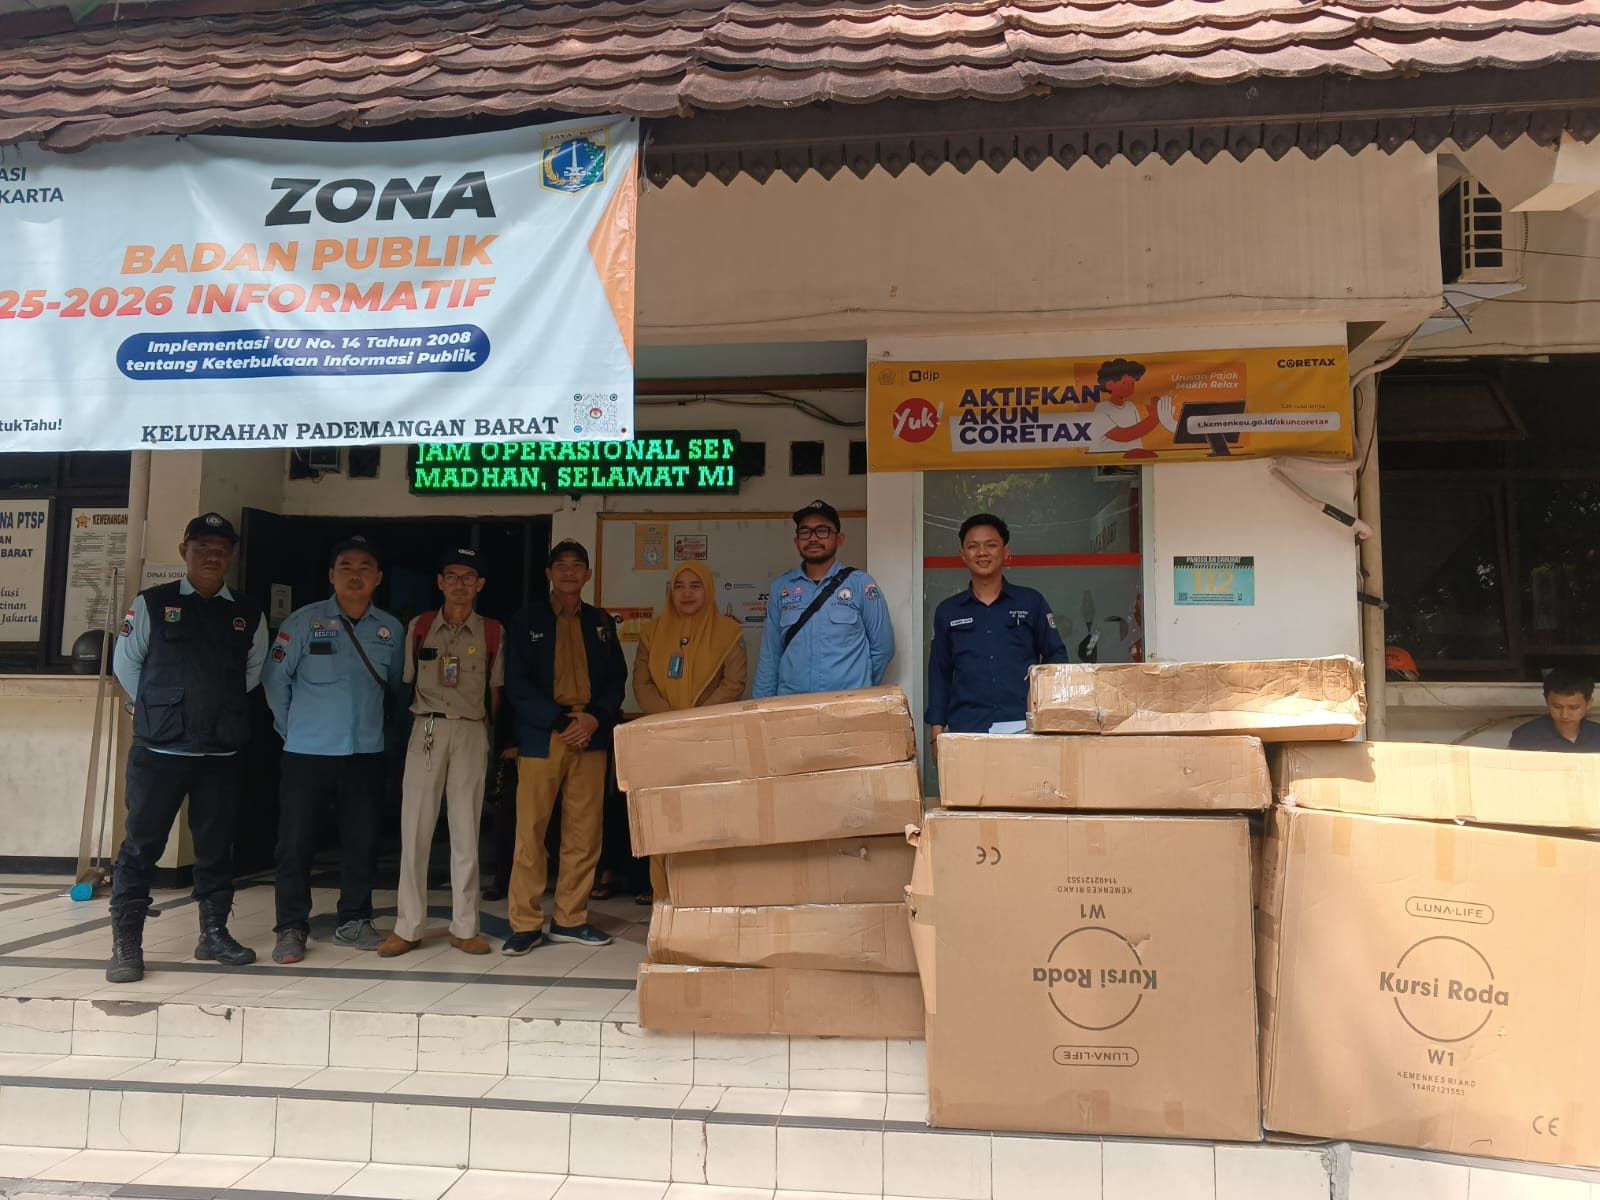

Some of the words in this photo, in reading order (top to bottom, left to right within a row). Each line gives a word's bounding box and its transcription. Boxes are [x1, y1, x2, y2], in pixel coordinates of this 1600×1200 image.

[265, 171, 496, 227] ZONA
[120, 241, 298, 275] BADAN
[312, 234, 498, 271] PUBLIK
[186, 277, 496, 314] INFORMATIF
[148, 336, 269, 354] Implementasi
[274, 337, 301, 349] UU
[305, 337, 335, 349] No.
[342, 338, 360, 348] 14
[366, 336, 421, 347] Tahun
[426, 332, 471, 345] 2008
[126, 358, 197, 372] tentang
[202, 354, 318, 369] Keterbukaan
[323, 351, 414, 367] Informasi
[417, 349, 475, 363] Publik
[1277, 358, 1335, 368] CORETAX
[1171, 373, 1207, 382] Urusan
[1210, 372, 1239, 382] Pajak
[1176, 381, 1207, 389] Makin
[1210, 381, 1239, 389] Relax
[959, 385, 1100, 407] AKTIFKAN
[892, 400, 945, 440] Yuk!
[959, 407, 1039, 425] AKUN
[141, 423, 288, 442] KELURAHAN
[296, 420, 466, 439] PADEMANGAN
[474, 417, 558, 436] BARAT
[959, 423, 1092, 444] CORETAX
[481, 438, 680, 461] OPERASIONAL
[415, 467, 547, 491] MADHAN,
[557, 465, 689, 488] SELAMAT
[17, 511, 45, 529] PTSP
[1, 548, 33, 557] BARAT
[1192, 570, 1234, 593] 112
[1, 613, 38, 625] Jakarta
[1086, 886, 1132, 894] KEMENKES
[1080, 904, 1105, 919] W1
[1033, 967, 1092, 988] Roda
[1100, 969, 1157, 989] Kursi
[1380, 971, 1439, 998] Kursi
[1447, 979, 1509, 1006] Roda
[1397, 1071, 1446, 1084] KEMENKES
